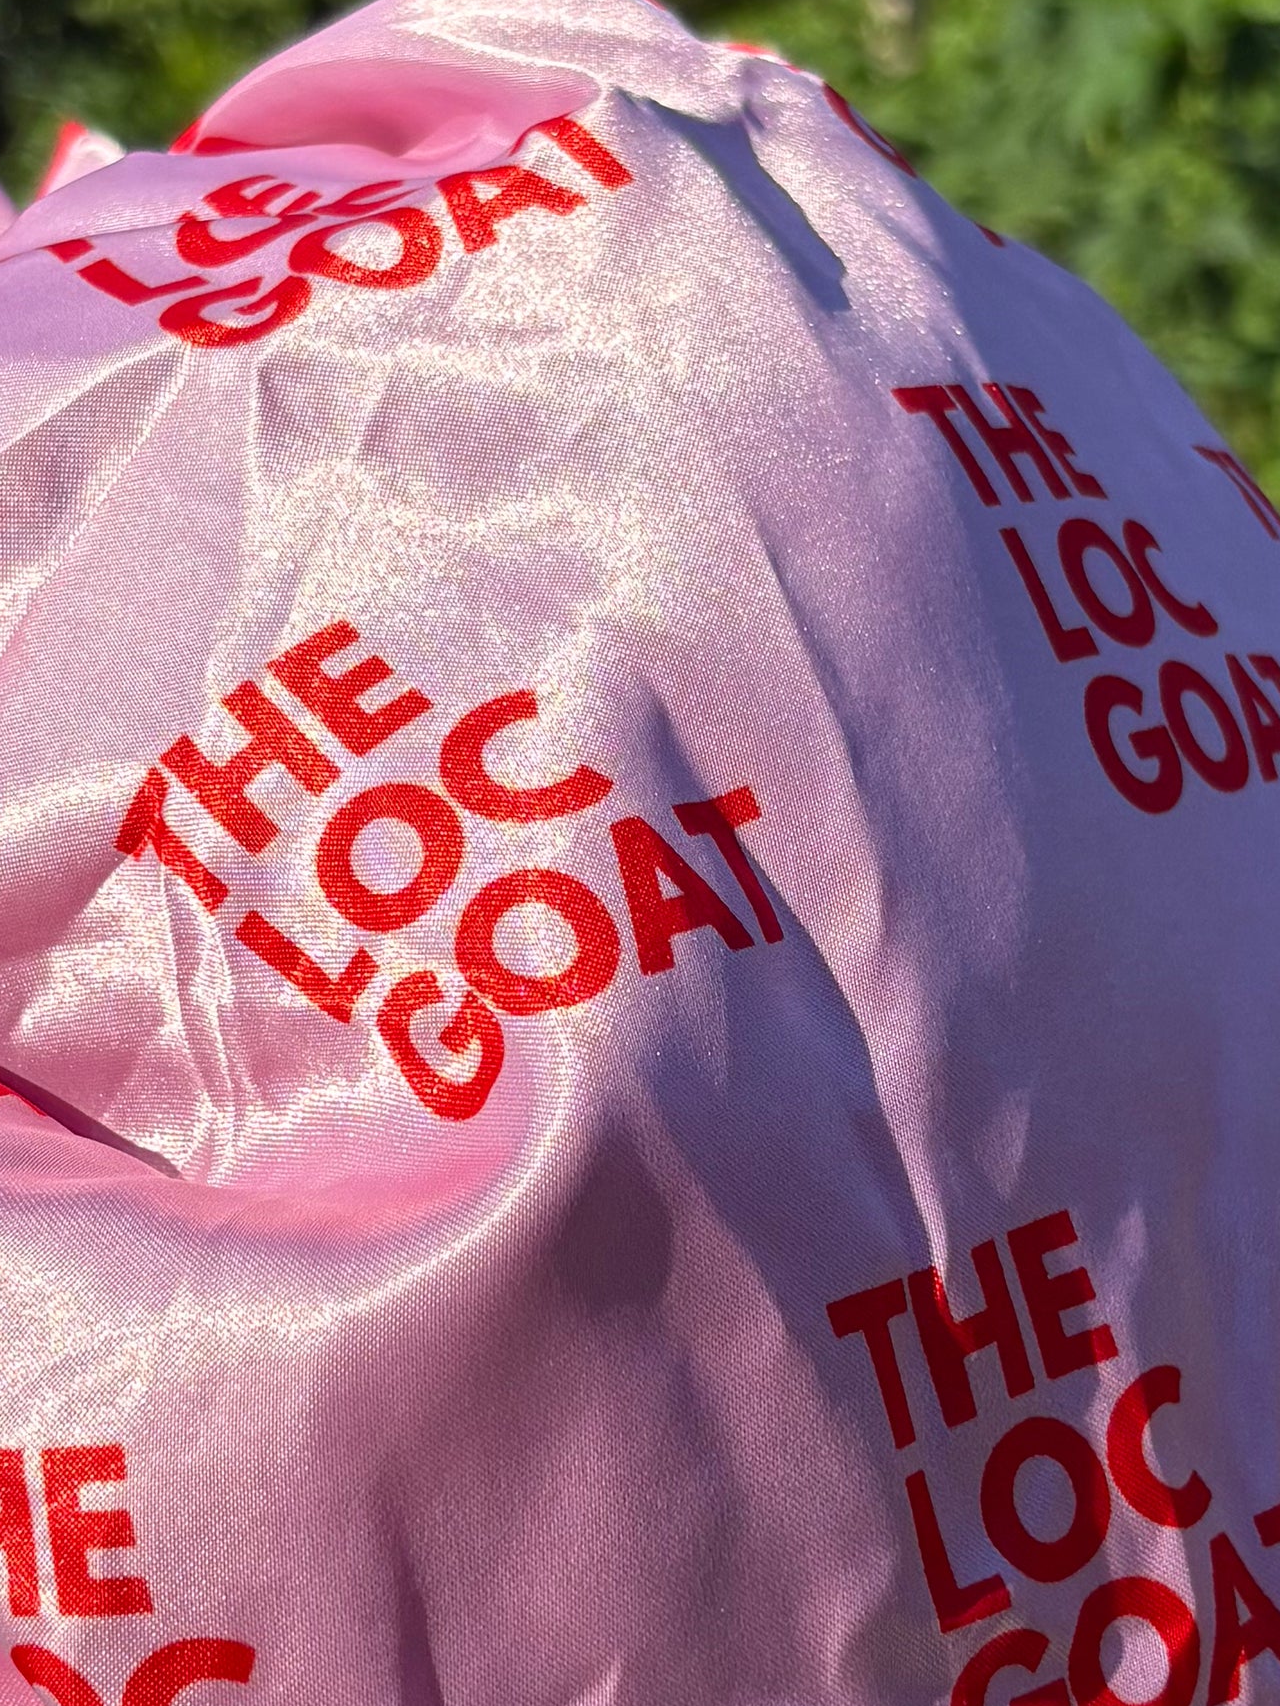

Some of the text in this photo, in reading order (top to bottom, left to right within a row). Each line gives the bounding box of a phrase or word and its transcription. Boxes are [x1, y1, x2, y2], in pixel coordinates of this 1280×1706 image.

[893, 383, 1108, 507] THE
[1001, 518, 1218, 663] LOC
[114, 619, 432, 914] THE
[235, 690, 613, 1024] LOC
[377, 786, 783, 1121] GOAT
[827, 1209, 1118, 1449] THE
[905, 1364, 1211, 1633] LOC
